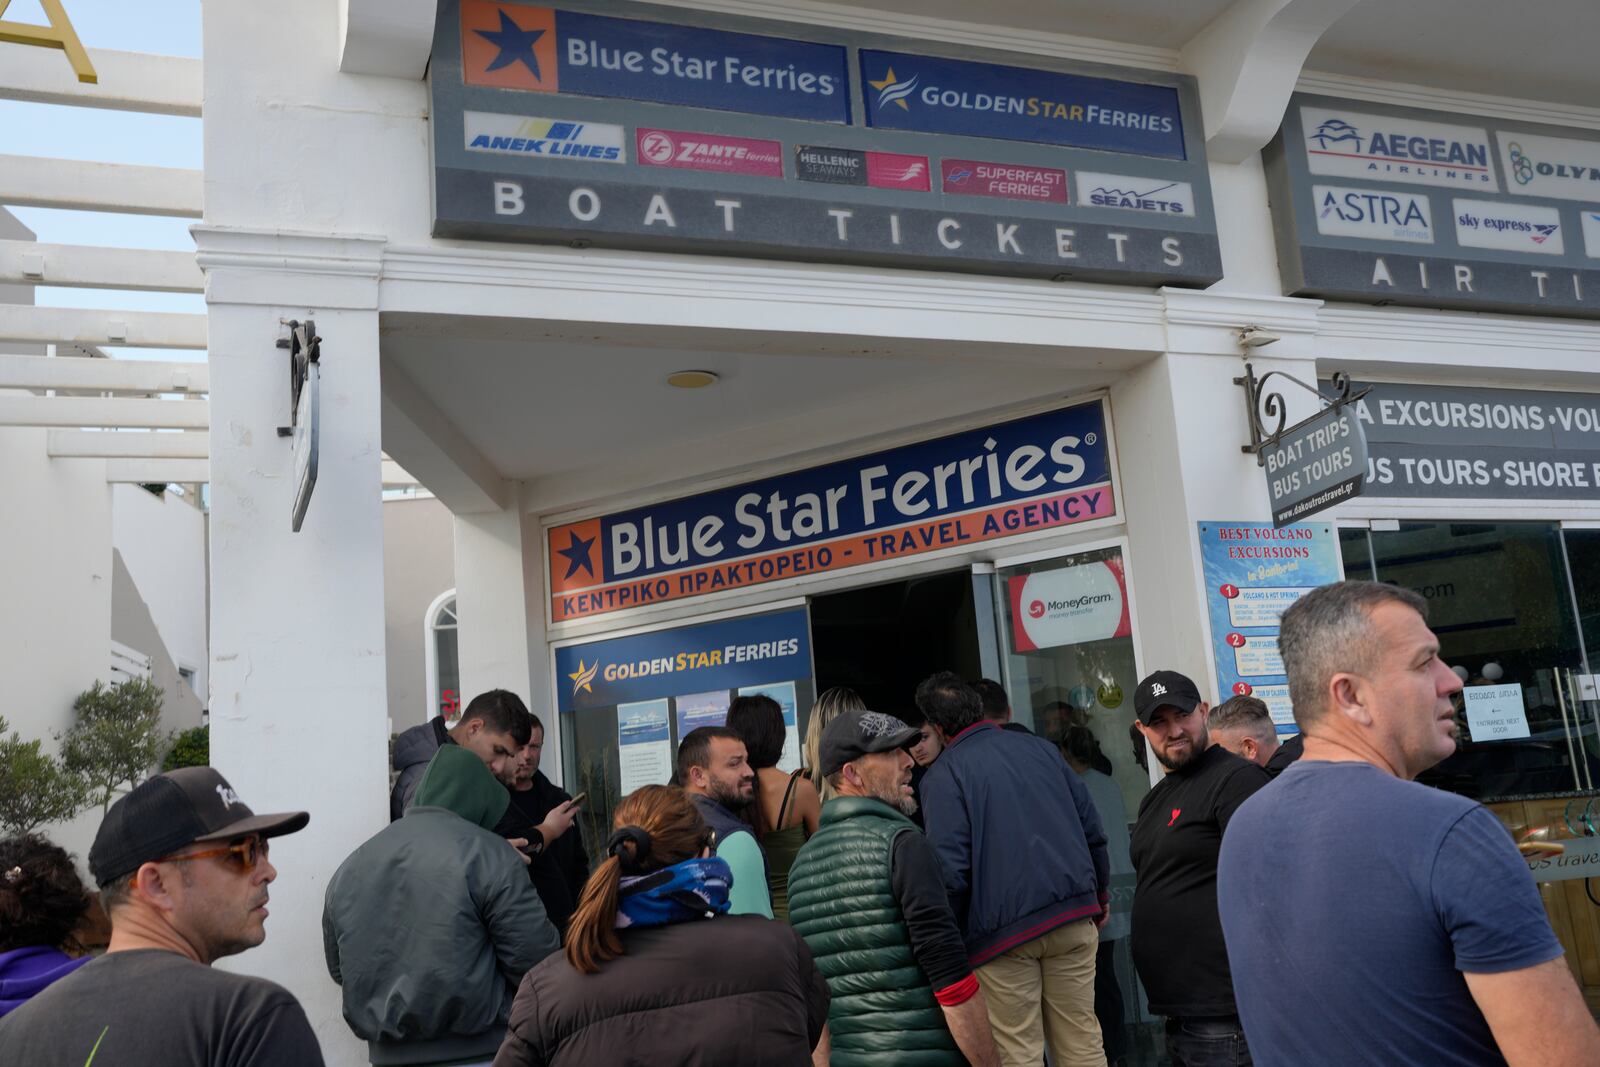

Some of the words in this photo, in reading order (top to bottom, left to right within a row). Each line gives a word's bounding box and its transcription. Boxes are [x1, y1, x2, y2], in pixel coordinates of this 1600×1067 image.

[568, 38, 643, 73] Blue
[651, 47, 718, 81] Star
[725, 58, 835, 95] Ferries
[470, 135, 546, 155] ANEK
[549, 140, 620, 161] LINES
[676, 142, 748, 162] ZANTE
[1369, 133, 1487, 166] AEGEAN
[801, 153, 859, 168] HELLENIC
[806, 164, 857, 177] SEAWAYS
[976, 166, 1062, 184] SUPERFAST
[1368, 162, 1489, 182] AIRLINES
[989, 181, 1051, 197] FERRIES
[1089, 194, 1183, 214] SEAJETS
[1321, 191, 1428, 227] ASTRA
[494, 182, 742, 232] BOAT
[828, 209, 1182, 266] TICKETS
[1459, 213, 1480, 228] sky
[1484, 217, 1531, 233] express
[1394, 228, 1429, 240] airlines
[1372, 258, 1474, 292] AIR
[1267, 439, 1303, 473] BOAT
[1306, 416, 1351, 452] TRIPS
[1273, 472, 1300, 499] BUS
[1303, 446, 1352, 484] TOURS
[611, 515, 725, 577] Blue
[735, 484, 848, 548] Star
[1220, 528, 1250, 540] BEST
[1254, 528, 1312, 540] VOLCANO
[563, 580, 670, 617] ΚΕΝΤΡΙΚΟ
[680, 546, 833, 593] ΠΡΑΚΤΟΡΕΙΟ
[864, 520, 971, 559] TRAVEL
[982, 491, 1102, 536] AGENCY
[1229, 547, 1309, 558] EXCURSIONS
[1226, 585, 1232, 597] 1
[1231, 634, 1240, 646] 2
[1239, 684, 1246, 695] 3
